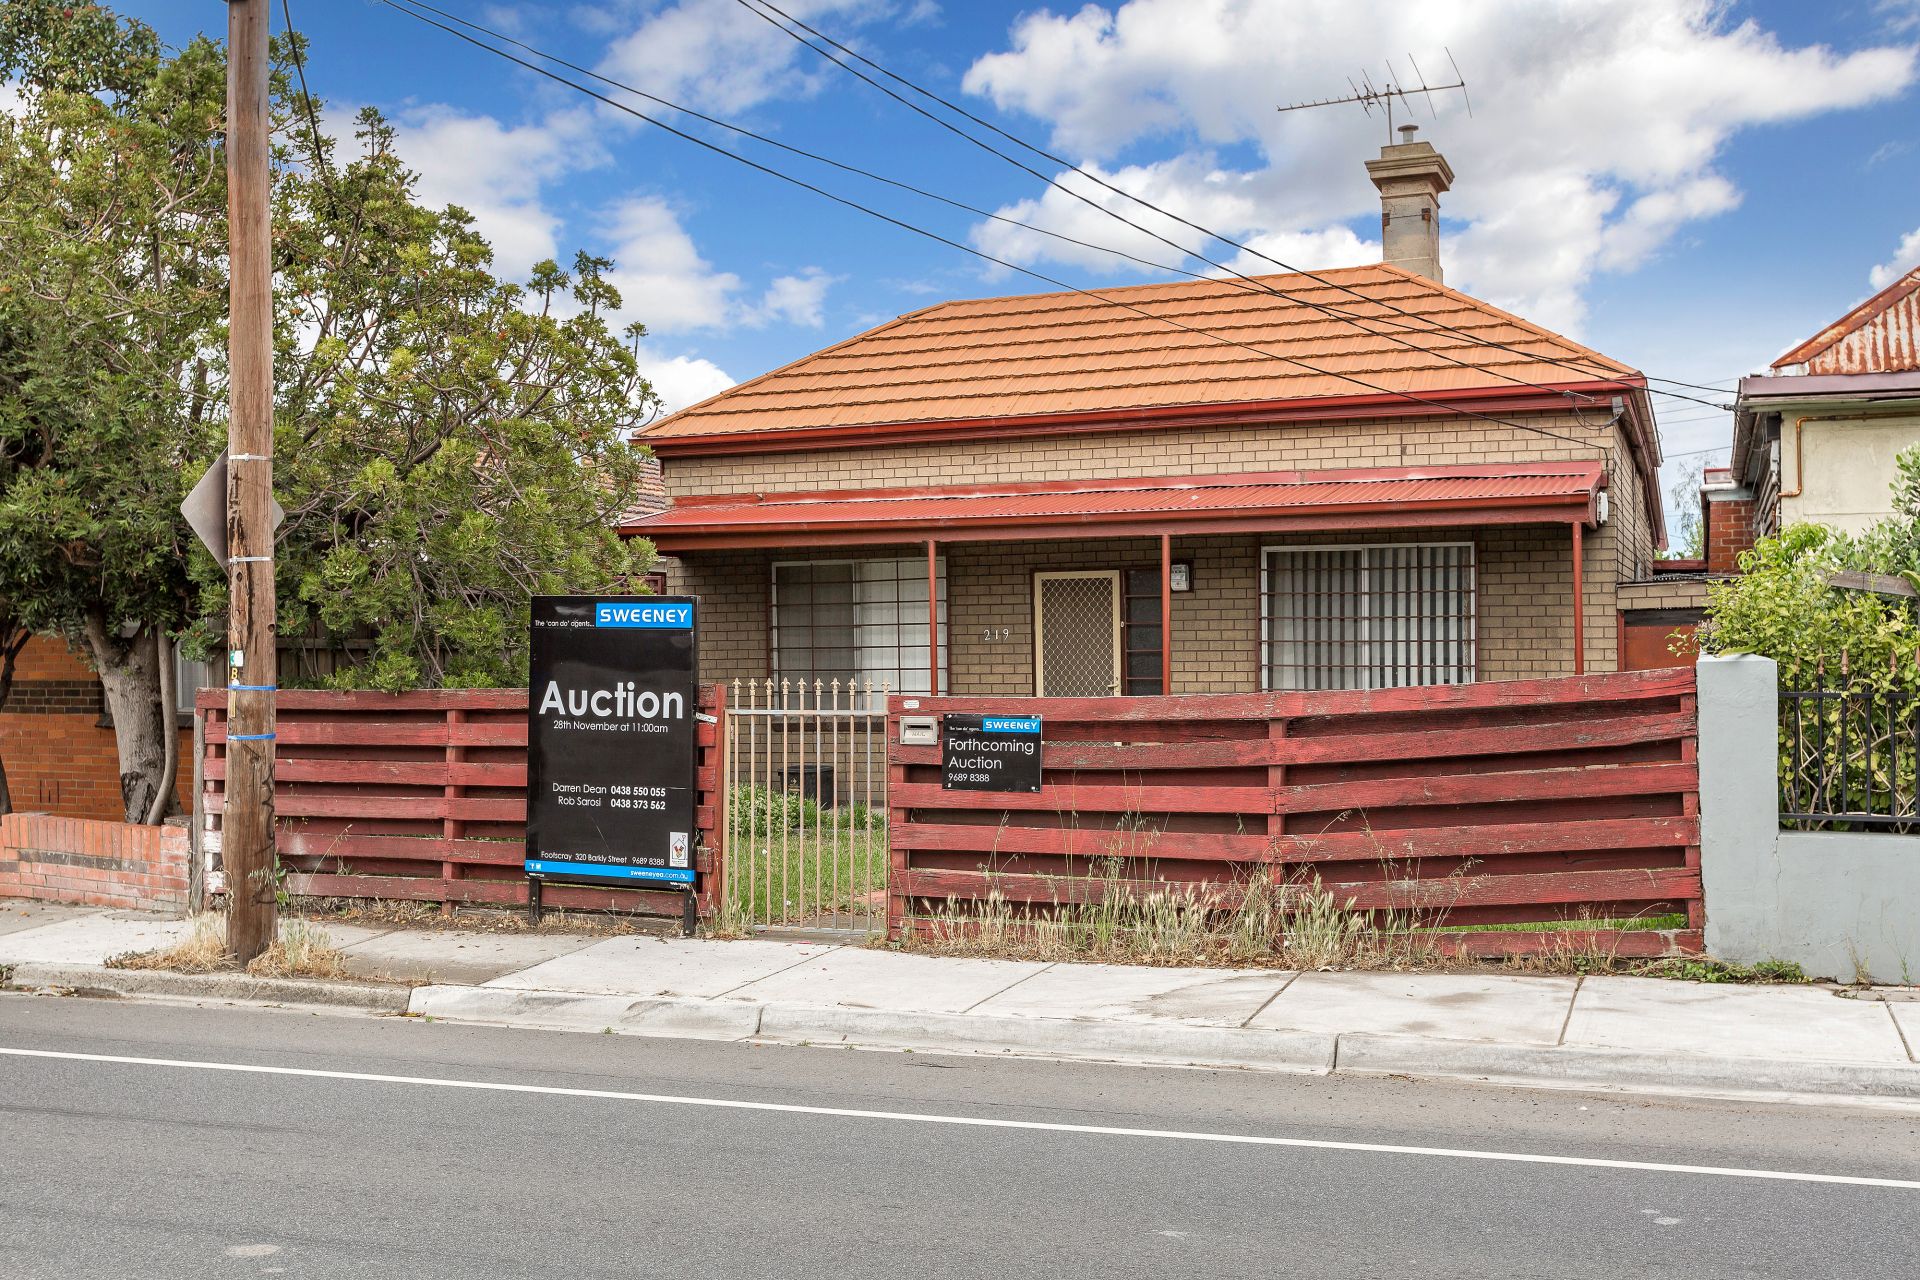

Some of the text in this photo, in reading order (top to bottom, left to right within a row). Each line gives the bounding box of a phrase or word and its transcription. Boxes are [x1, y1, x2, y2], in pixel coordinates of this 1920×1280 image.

[600, 609, 688, 623] SWEENEY
[984, 628, 1009, 640] 219
[231, 667, 238, 679] B
[538, 680, 683, 719] Auction
[553, 720, 669, 733] 28th November at 11:00am
[985, 721, 1038, 730] SWEENEY
[949, 738, 1034, 755] Forthcoming
[948, 756, 1002, 769] Auction
[948, 772, 990, 782] 9689 8388
[552, 782, 666, 797] Darren Dean 0438 550 055
[558, 796, 666, 810] Rob Sarosi 0438 373 562
[540, 851, 573, 861] Footscray
[575, 852, 587, 861] 320
[588, 853, 606, 864] Barkly
[607, 854, 628, 864] Street
[632, 856, 648, 865] 9689
[648, 857, 665, 866] 8388
[630, 870, 689, 880] sweeneyea.com.au
